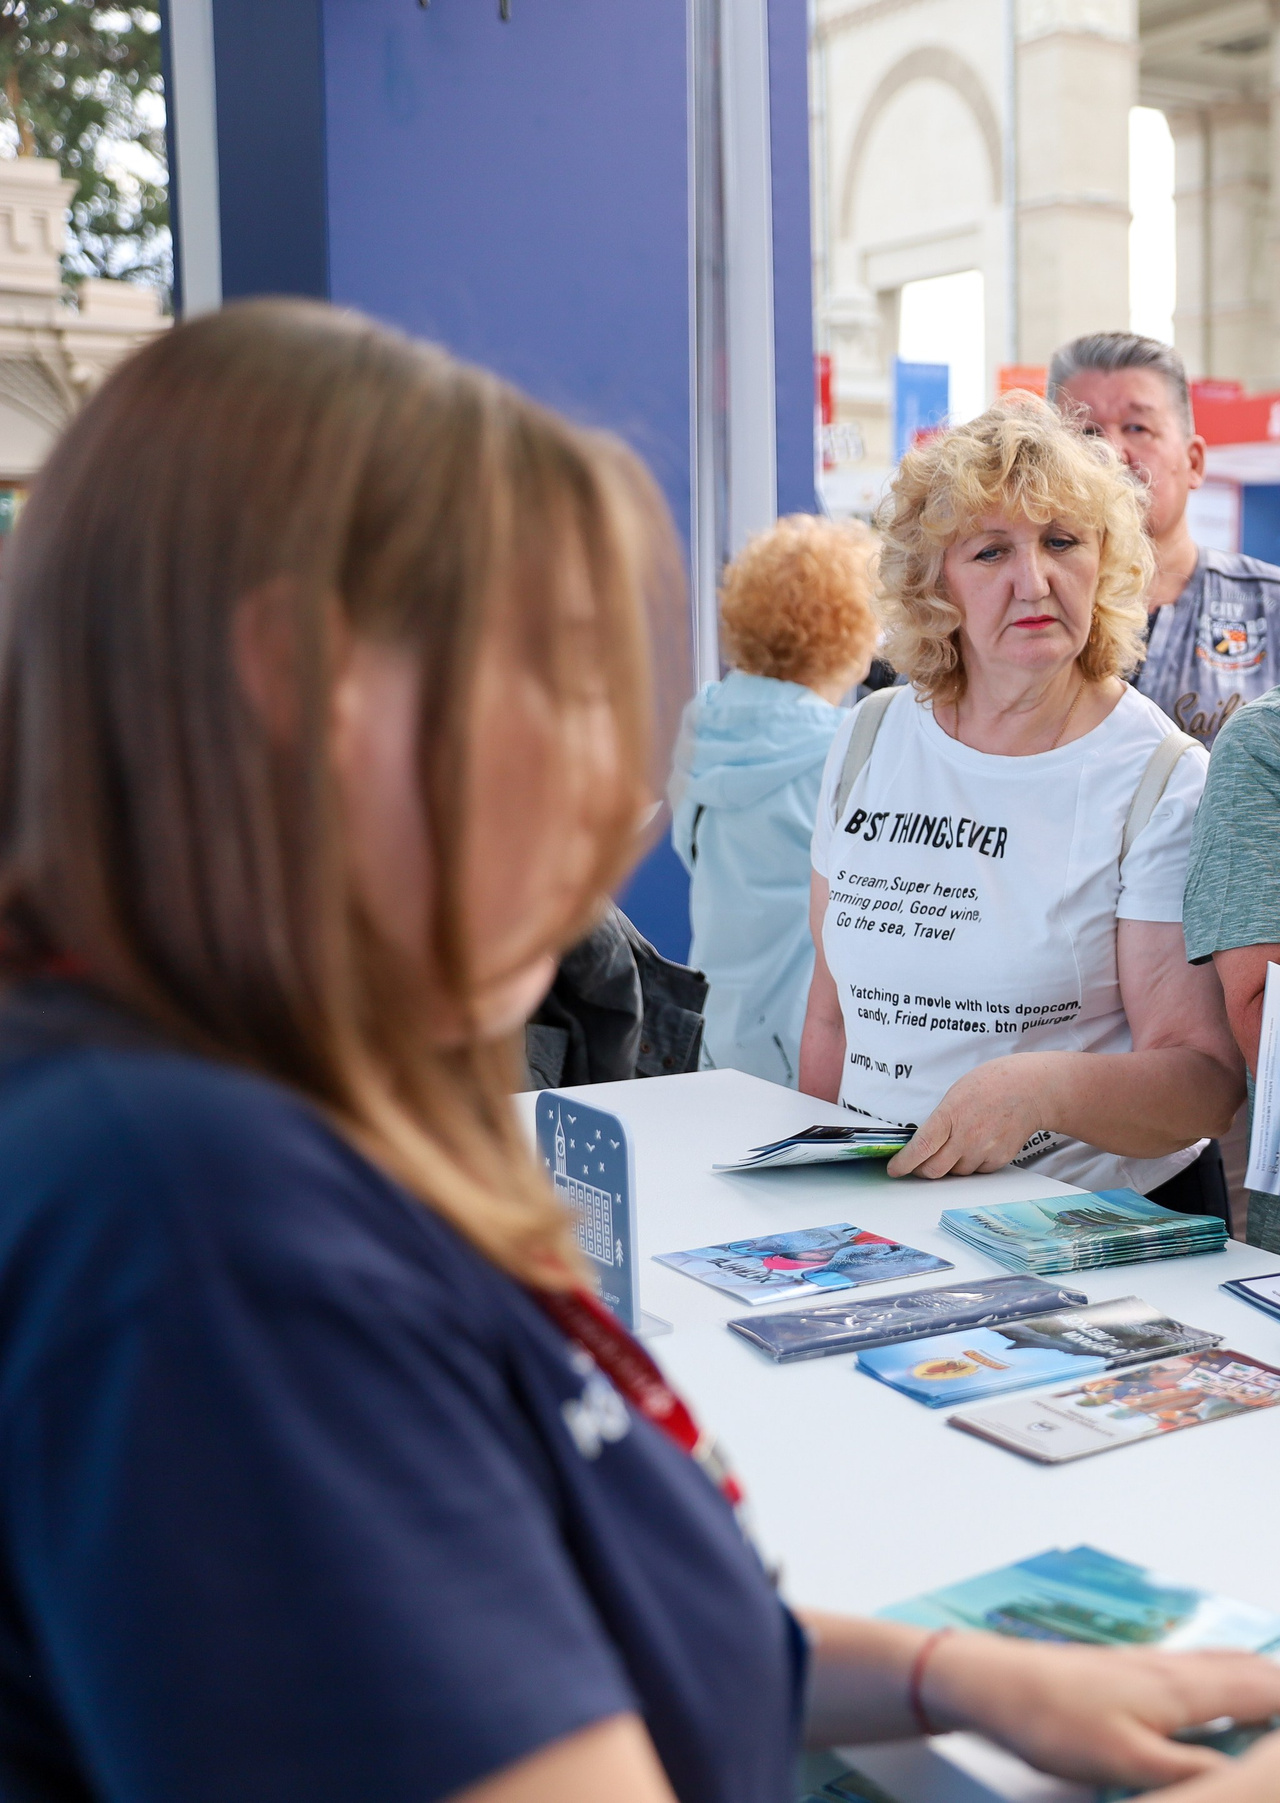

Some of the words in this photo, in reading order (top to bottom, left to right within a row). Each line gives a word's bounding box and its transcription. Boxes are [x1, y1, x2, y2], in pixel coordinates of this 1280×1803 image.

[1174, 692, 1246, 735] Sail
[844, 808, 890, 842] BST
[956, 817, 1008, 859] EVER
[890, 876, 930, 895] Super
[872, 898, 904, 914] pool,
[909, 900, 948, 917] Good
[950, 907, 982, 923] wine,
[836, 912, 852, 927] Go
[855, 915, 876, 931] the
[879, 921, 907, 938] sea,
[913, 922, 956, 941] Travel
[903, 994, 911, 1005] a
[986, 1001, 1010, 1014] lots
[894, 1010, 928, 1028] Fried
